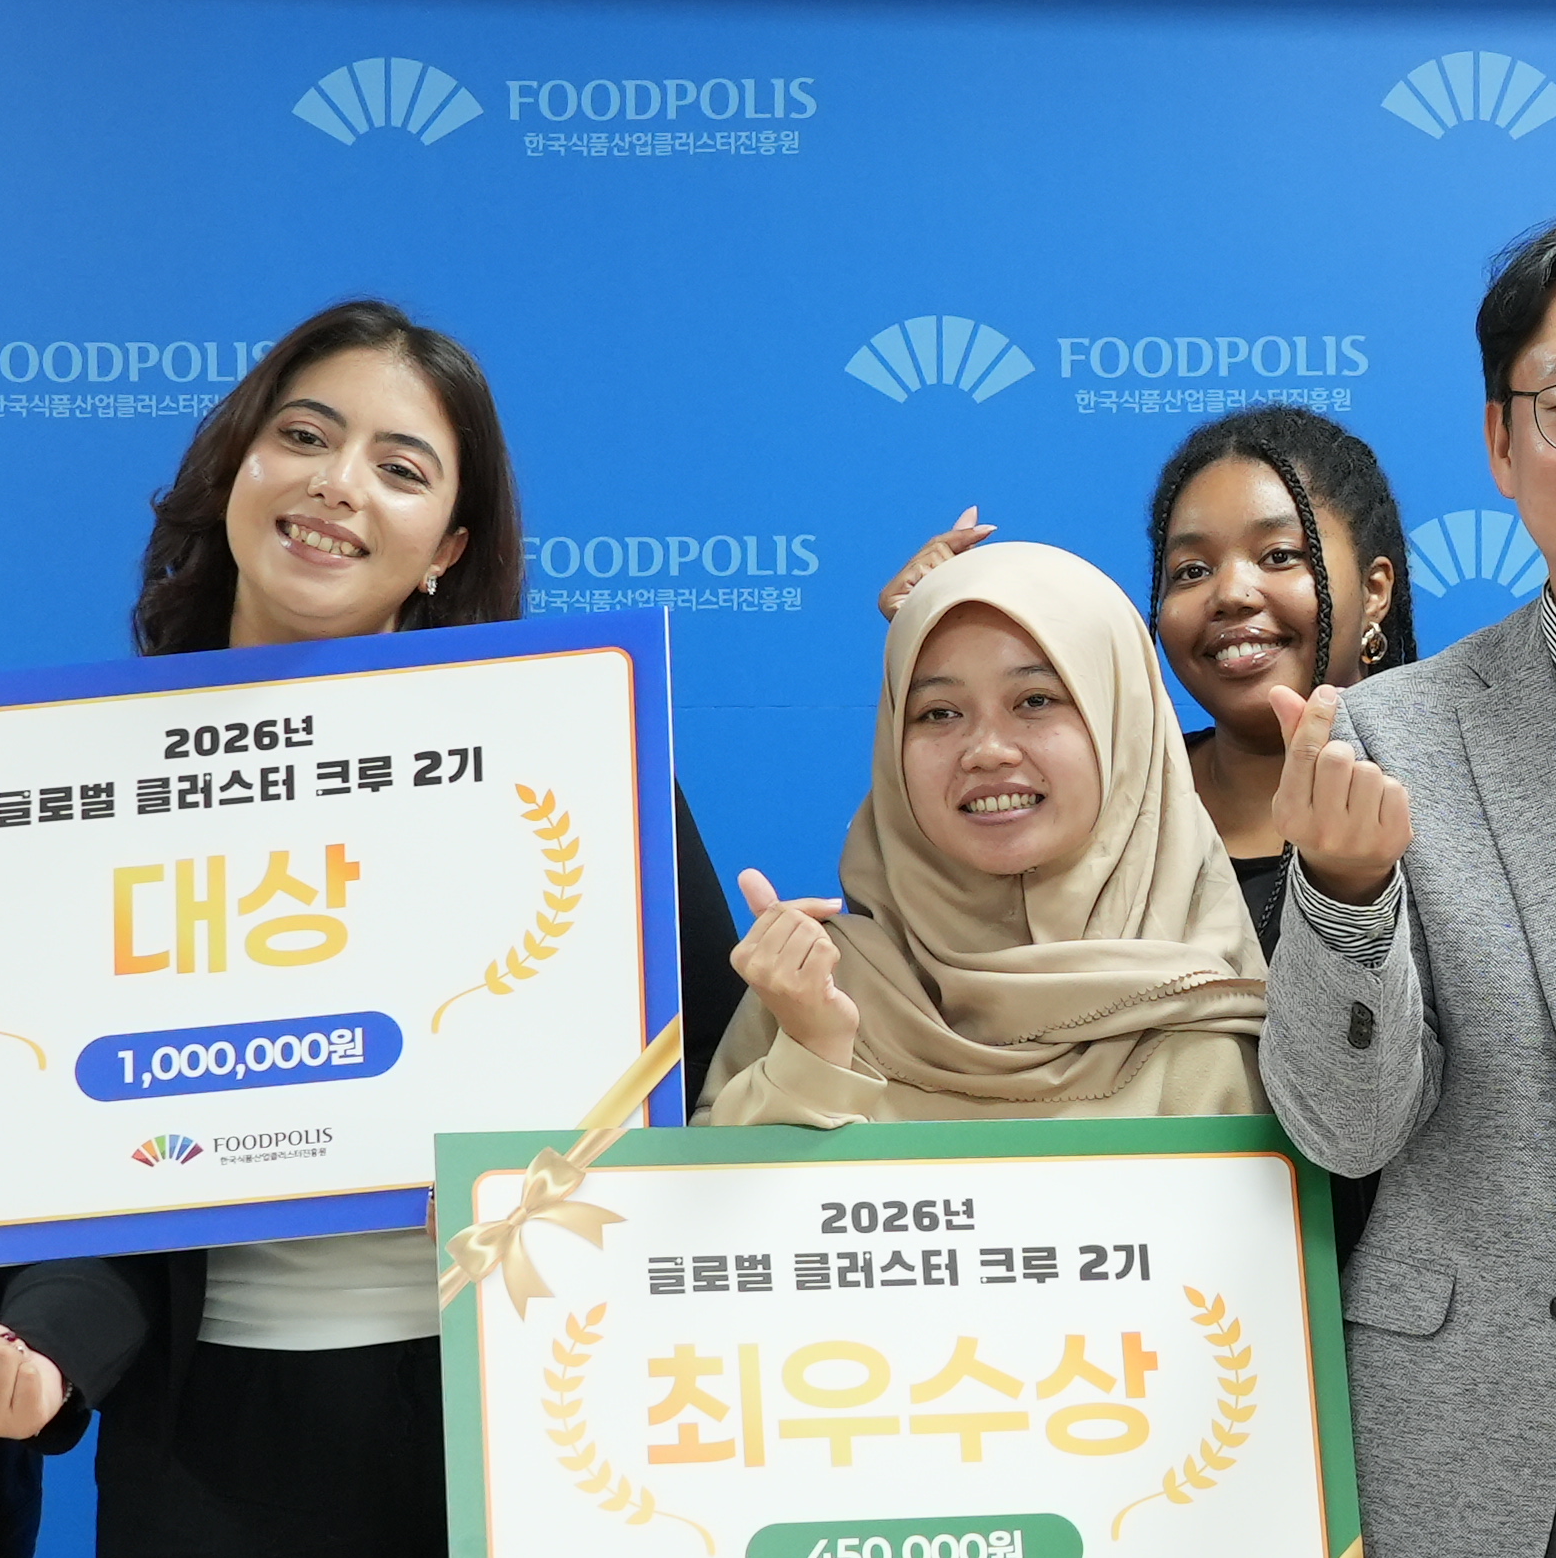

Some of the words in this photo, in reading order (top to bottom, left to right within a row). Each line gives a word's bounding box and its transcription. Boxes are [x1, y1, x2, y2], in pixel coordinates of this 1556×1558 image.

[506, 78, 817, 121] FOODPOLIS
[524, 131, 799, 156] 한국식품산업클러스터진흥원
[1058, 335, 1368, 378] FOODPOLIS
[1075, 388, 1351, 415] 한국식품산업클러스터진흥원
[165, 716, 313, 759] 2026년
[136, 766, 294, 814] 클러스터
[316, 756, 393, 796] 크루
[414, 746, 482, 786] 2기
[114, 844, 360, 975] 대상
[118, 1027, 364, 1089] 1,000,000원
[213, 1127, 333, 1153] FOODPOLIS
[220, 1147, 327, 1165] 한국식품산업클러스터진흥원
[821, 1199, 974, 1233] 2026년
[648, 1254, 772, 1294] 글로벌
[794, 1249, 958, 1290] 클러스터
[980, 1247, 1058, 1283] 크루
[1079, 1244, 1150, 1281] 2기
[648, 1332, 1159, 1467] 최우수상
